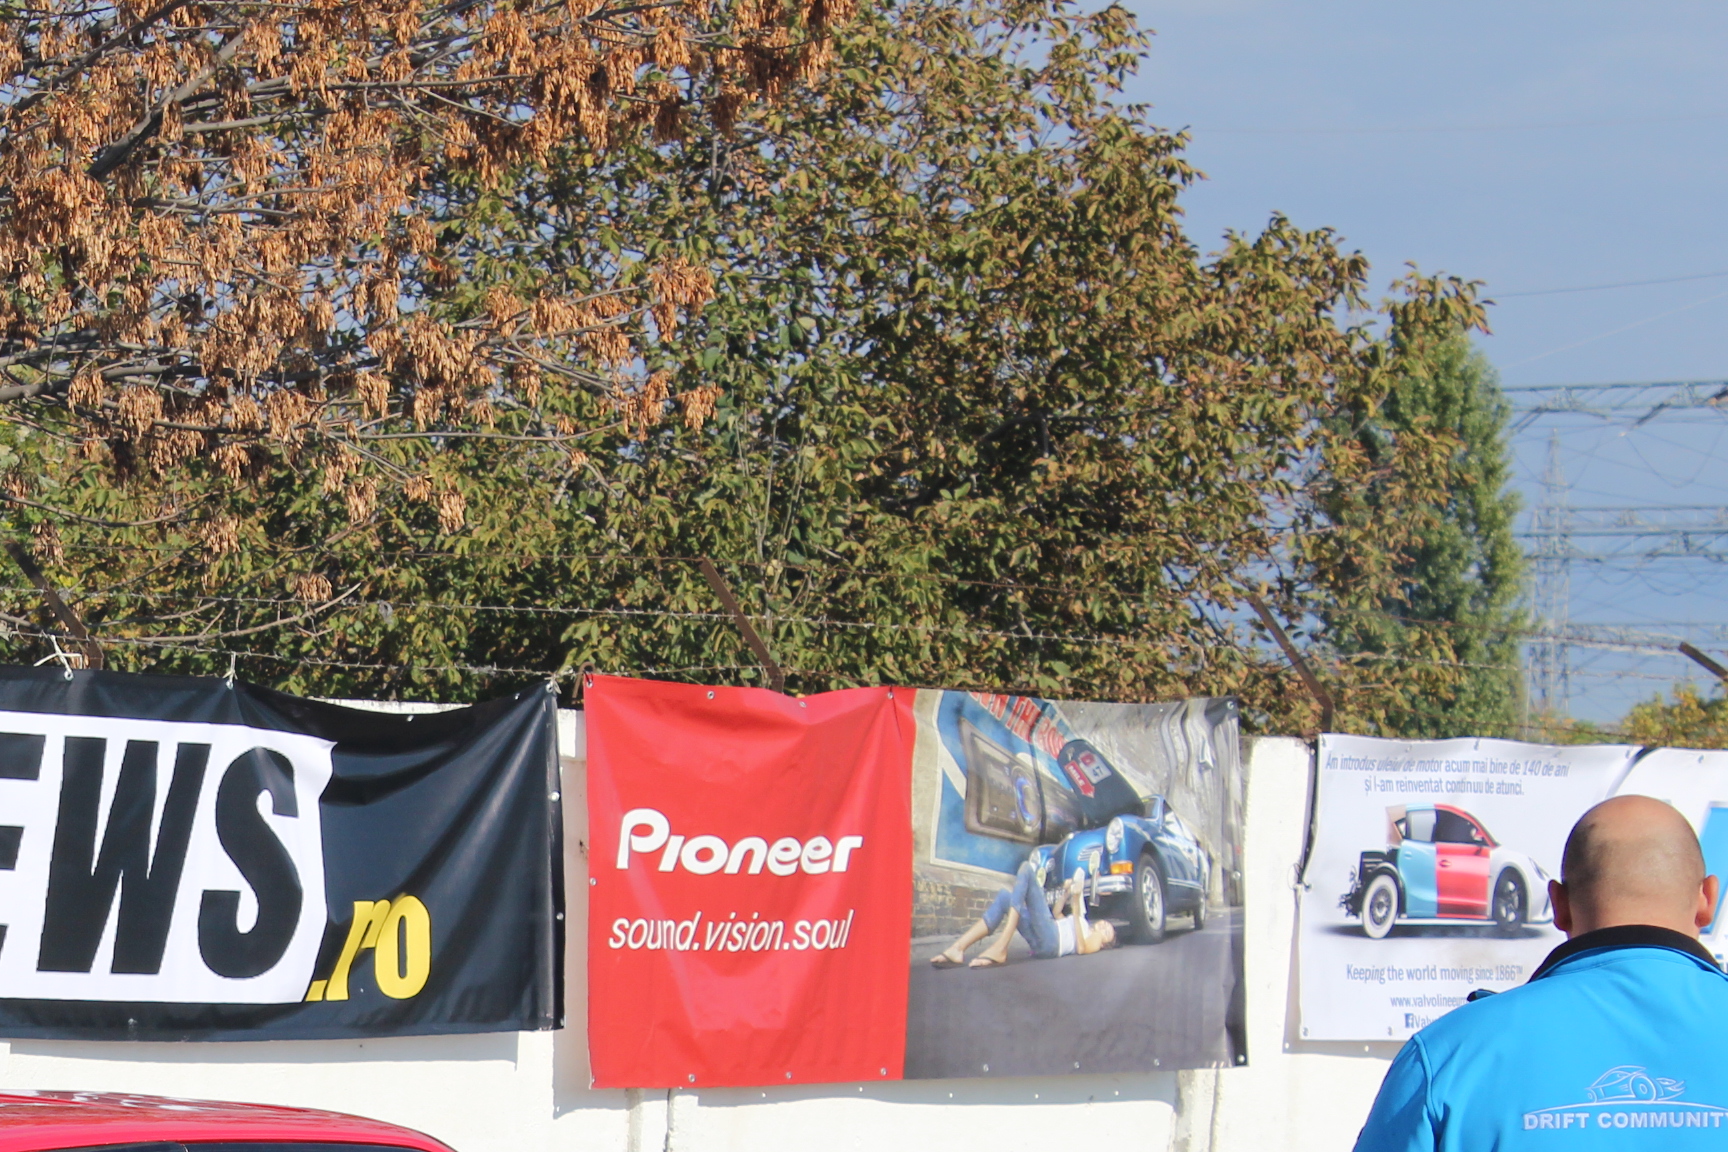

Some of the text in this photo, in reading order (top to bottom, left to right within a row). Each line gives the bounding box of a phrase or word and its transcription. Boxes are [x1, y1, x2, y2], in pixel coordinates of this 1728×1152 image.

[1340, 754, 1376, 771] introdus
[1403, 757, 1415, 772] de
[1416, 757, 1443, 773] motor
[1445, 760, 1471, 774] acum
[1472, 758, 1488, 774] mai
[1489, 757, 1508, 775] bine
[1509, 759, 1521, 775] de
[1522, 759, 1541, 776] 140
[1542, 760, 1554, 776] de
[1555, 761, 1571, 777] ani
[1396, 777, 1444, 793] reinventat
[1485, 778, 1494, 794] de
[1495, 780, 1525, 796] atunci.
[616, 808, 863, 876] Pioneer
[1347, 964, 1386, 985] Keeping
[1387, 965, 1404, 981] the
[1406, 965, 1437, 981] world
[1440, 966, 1474, 984] moving
[1475, 967, 1494, 981] since
[1523, 1112, 1590, 1131] DRIFT
